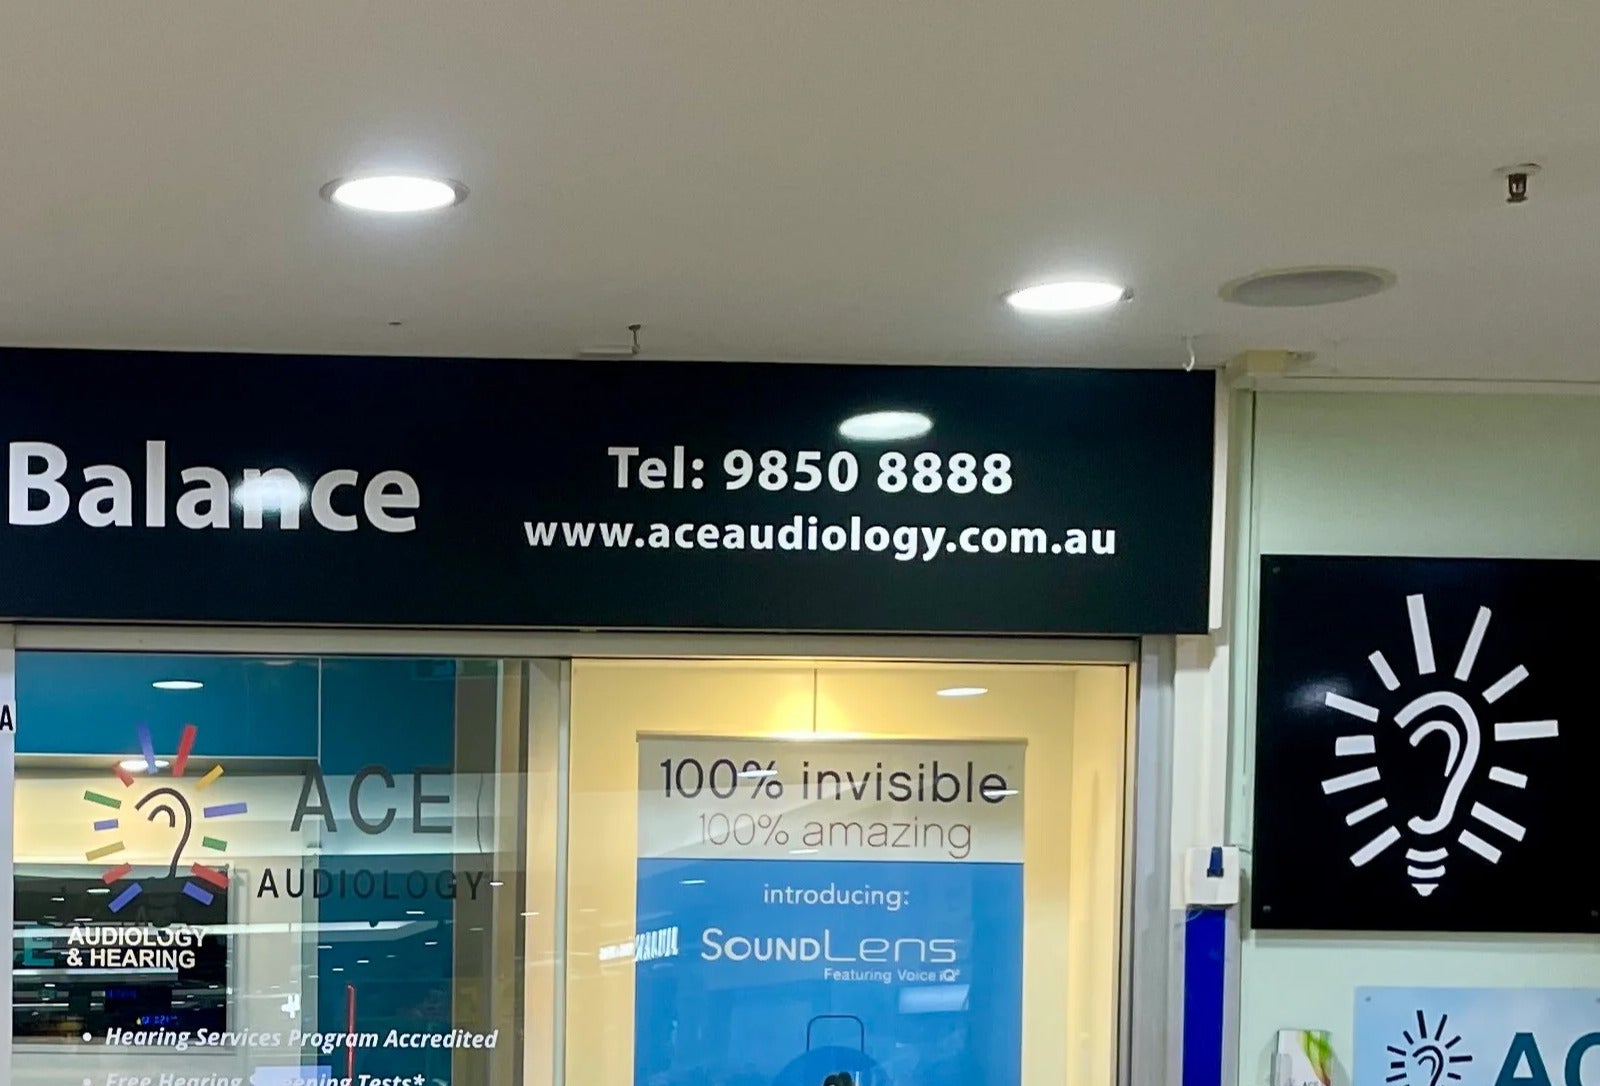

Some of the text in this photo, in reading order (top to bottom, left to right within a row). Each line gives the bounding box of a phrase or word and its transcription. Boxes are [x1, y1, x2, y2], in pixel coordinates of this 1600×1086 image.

[7, 440, 421, 532] Balance
[607, 446, 1013, 494] Tel: 9850 8888
[523, 515, 1117, 561] www.aceaudiology.com.au
[290, 764, 453, 835] ACE
[660, 758, 1008, 804] 100% invisible
[699, 812, 972, 859] 100% amazing
[257, 868, 484, 901] AUDIOLOGY
[763, 883, 909, 911] introducing:
[67, 927, 206, 947] AUDIOLOGY
[67, 949, 196, 969] & HEARING
[824, 968, 891, 984] Featuring
[898, 969, 935, 981] Voice
[105, 1028, 498, 1053] Hearing Services Program Accredited
